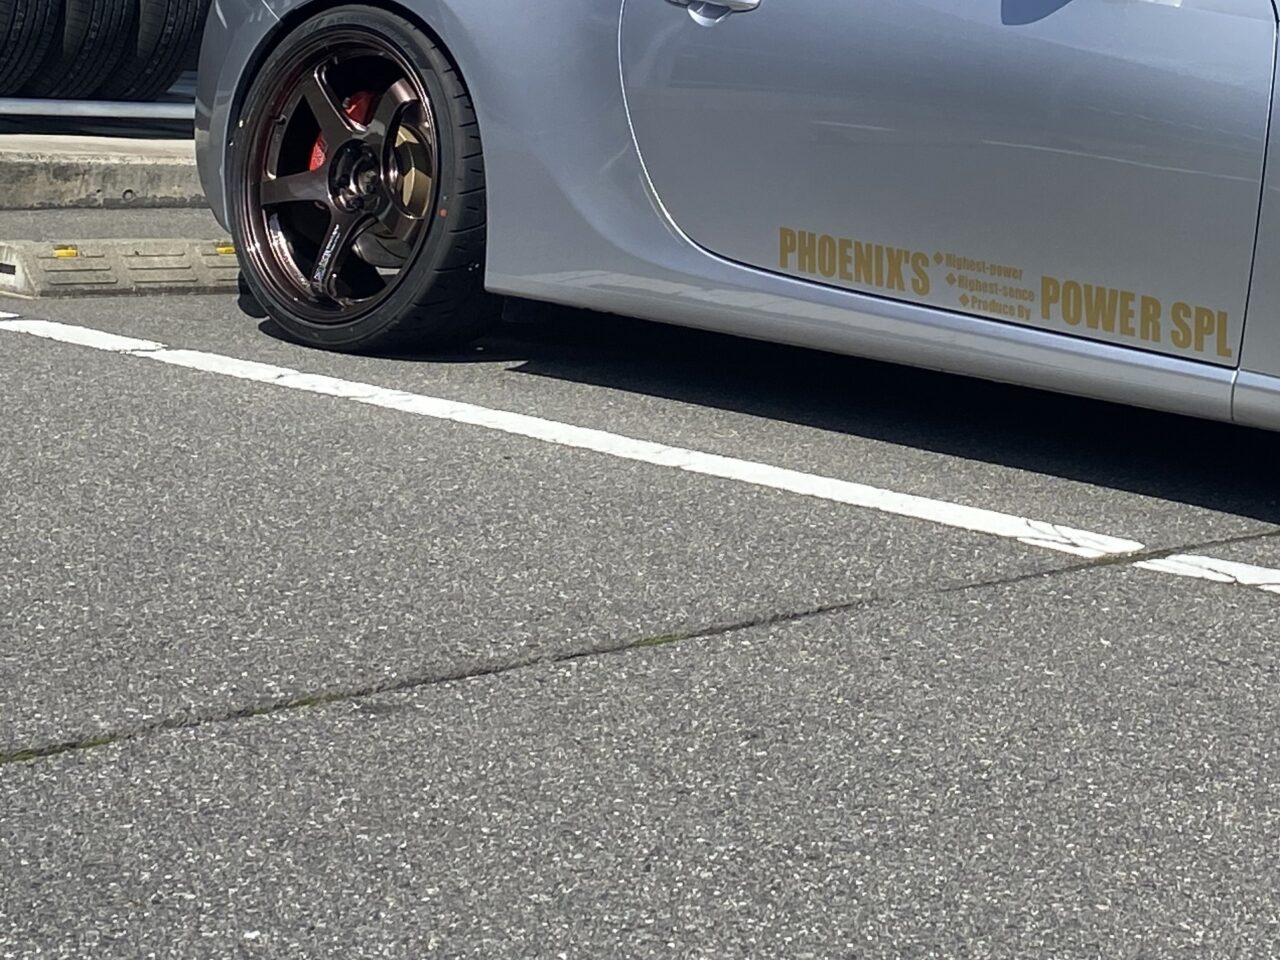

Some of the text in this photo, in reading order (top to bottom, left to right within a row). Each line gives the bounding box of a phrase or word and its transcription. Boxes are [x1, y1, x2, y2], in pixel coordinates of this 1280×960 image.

[779, 227, 930, 296] PHOENIX'S
[1041, 275, 1232, 358] POWER SPL
